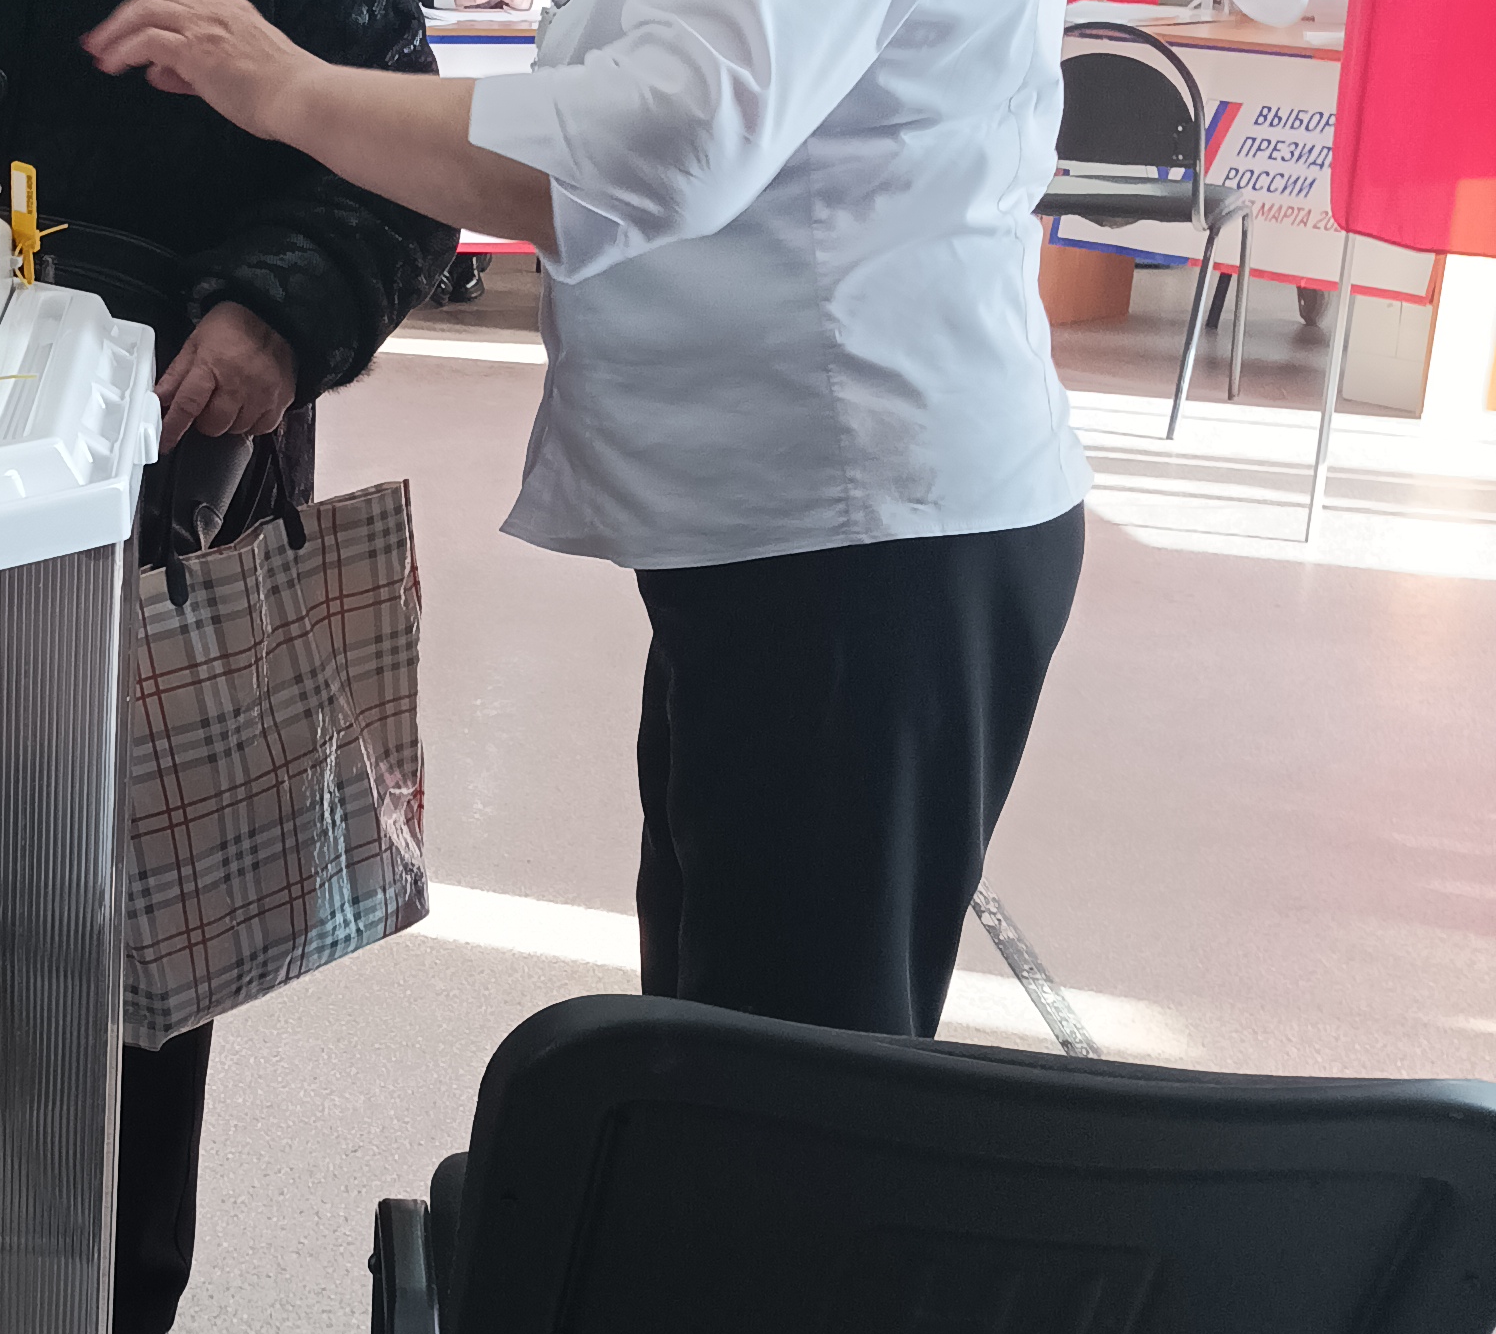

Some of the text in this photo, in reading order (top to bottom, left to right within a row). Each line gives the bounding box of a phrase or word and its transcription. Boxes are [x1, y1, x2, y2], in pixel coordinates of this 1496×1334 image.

[1253, 105, 1336, 134] ВЫБОР
[1236, 136, 1333, 172] ПРЕЗИД
[1222, 167, 1318, 199] РОССИИ
[1255, 202, 1313, 228] МАРТА
